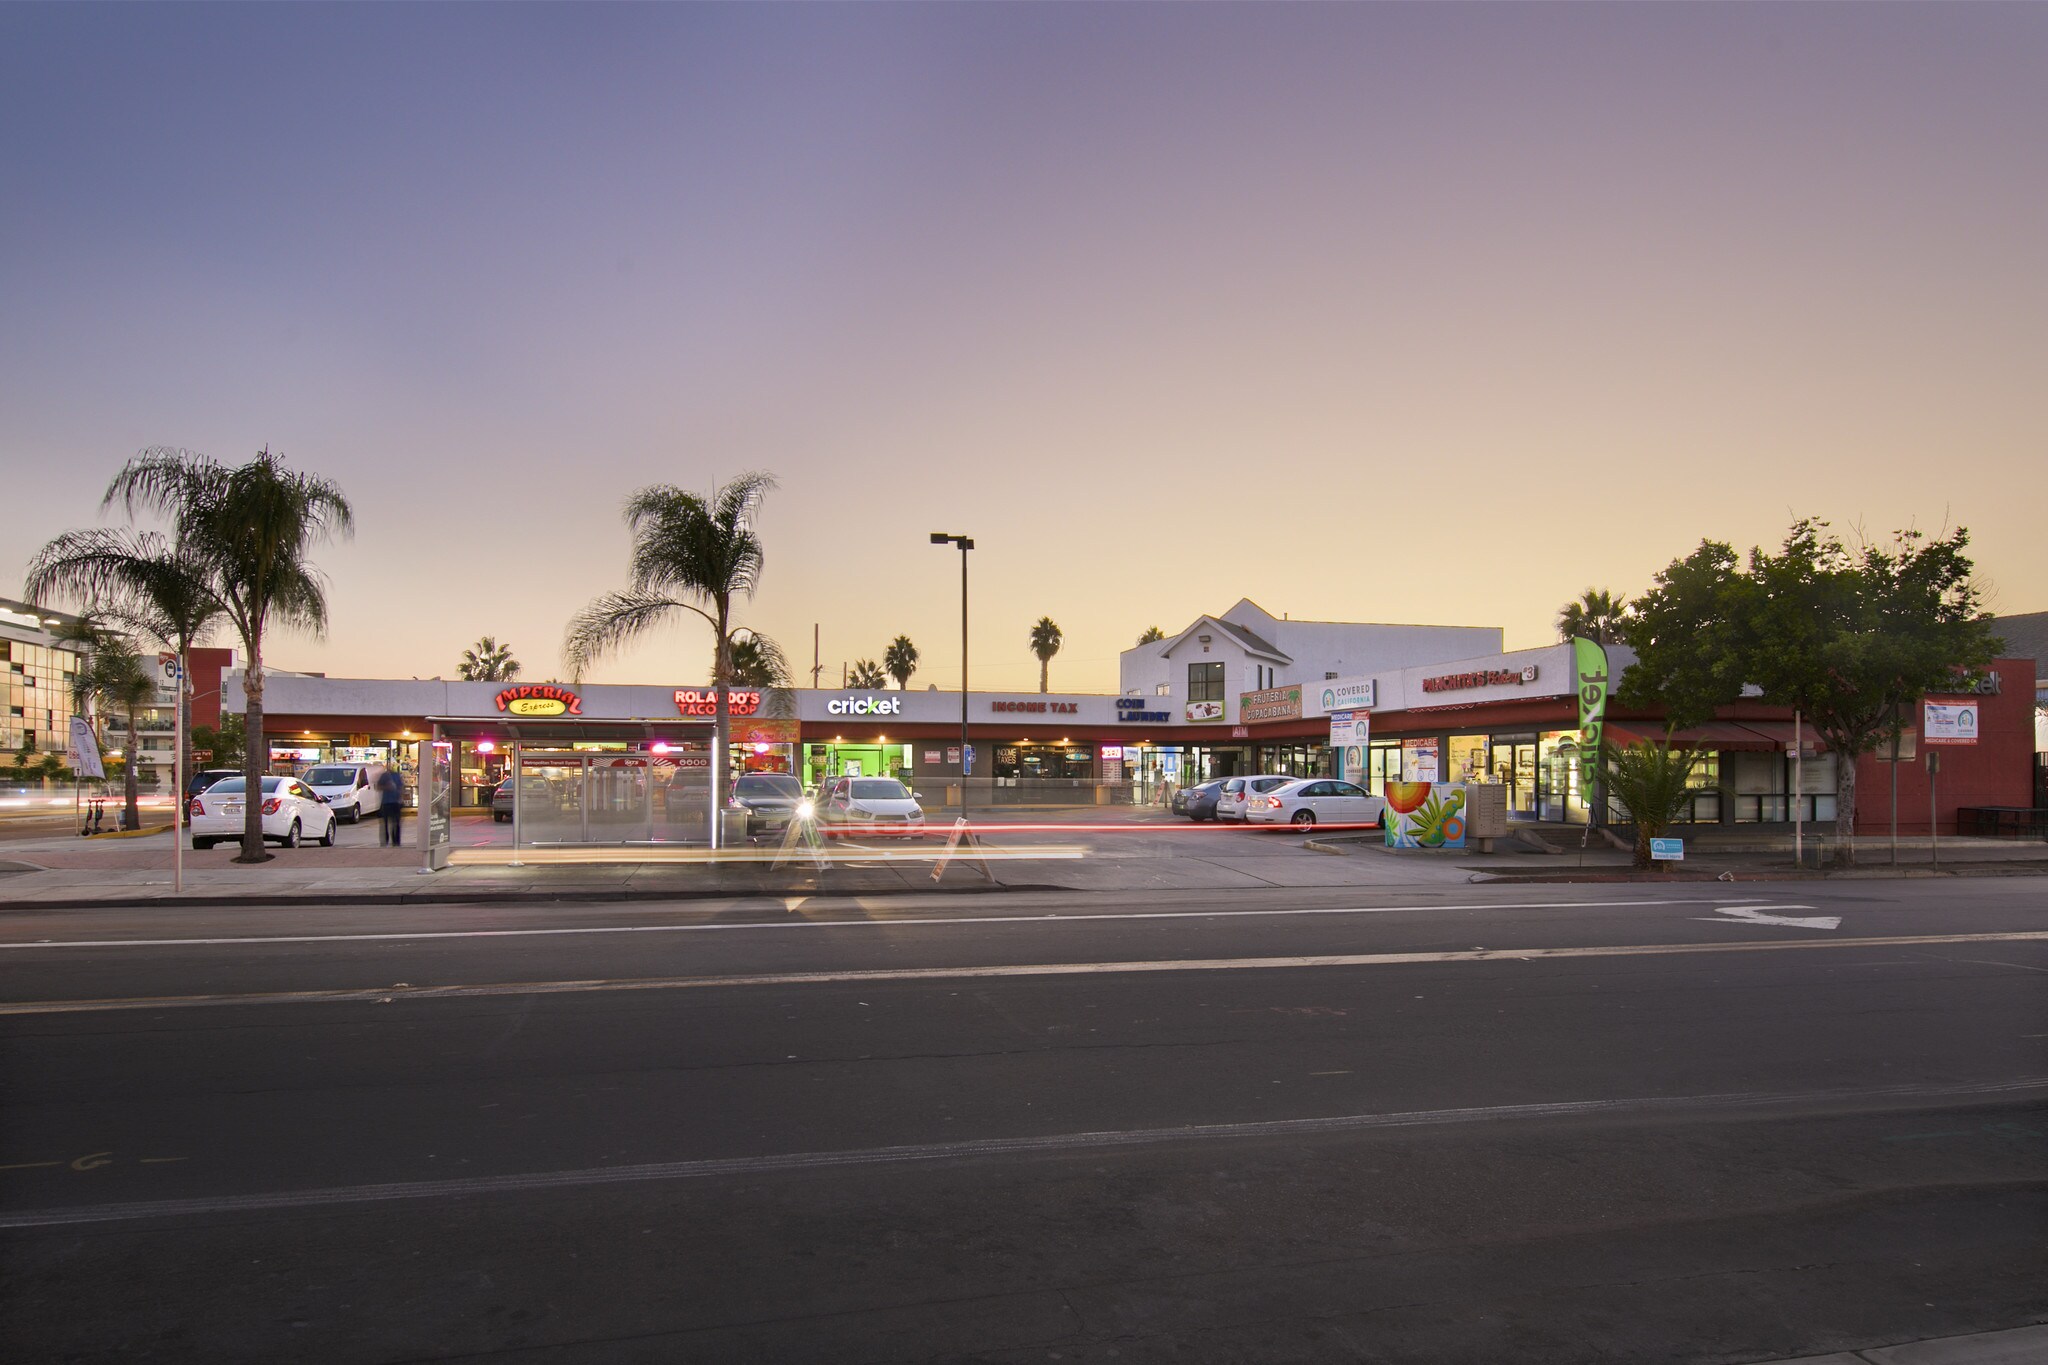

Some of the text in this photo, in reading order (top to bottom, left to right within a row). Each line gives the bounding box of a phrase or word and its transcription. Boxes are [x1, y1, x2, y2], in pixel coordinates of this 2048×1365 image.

[1336, 684, 1370, 697] COVERED
[495, 685, 583, 714] IMPERIAL
[674, 690, 760, 704] ROLADO'S
[1253, 690, 1287, 705] FRUTERIA
[1336, 695, 1370, 706] CALIFORNIA
[520, 702, 554, 712] Express
[678, 703, 758, 715] TACO HOP
[827, 696, 900, 714] cricket
[992, 702, 1078, 713] INCOME TAX
[1116, 698, 1145, 709] COIN
[1118, 711, 1171, 722] LAUNDRY
[1246, 704, 1292, 720] COPACABANA
[1233, 727, 1247, 736] ATM
[1580, 670, 1608, 785] cricket
[351, 735, 369, 747] ATM
[1404, 738, 1438, 748] MEDICARE
